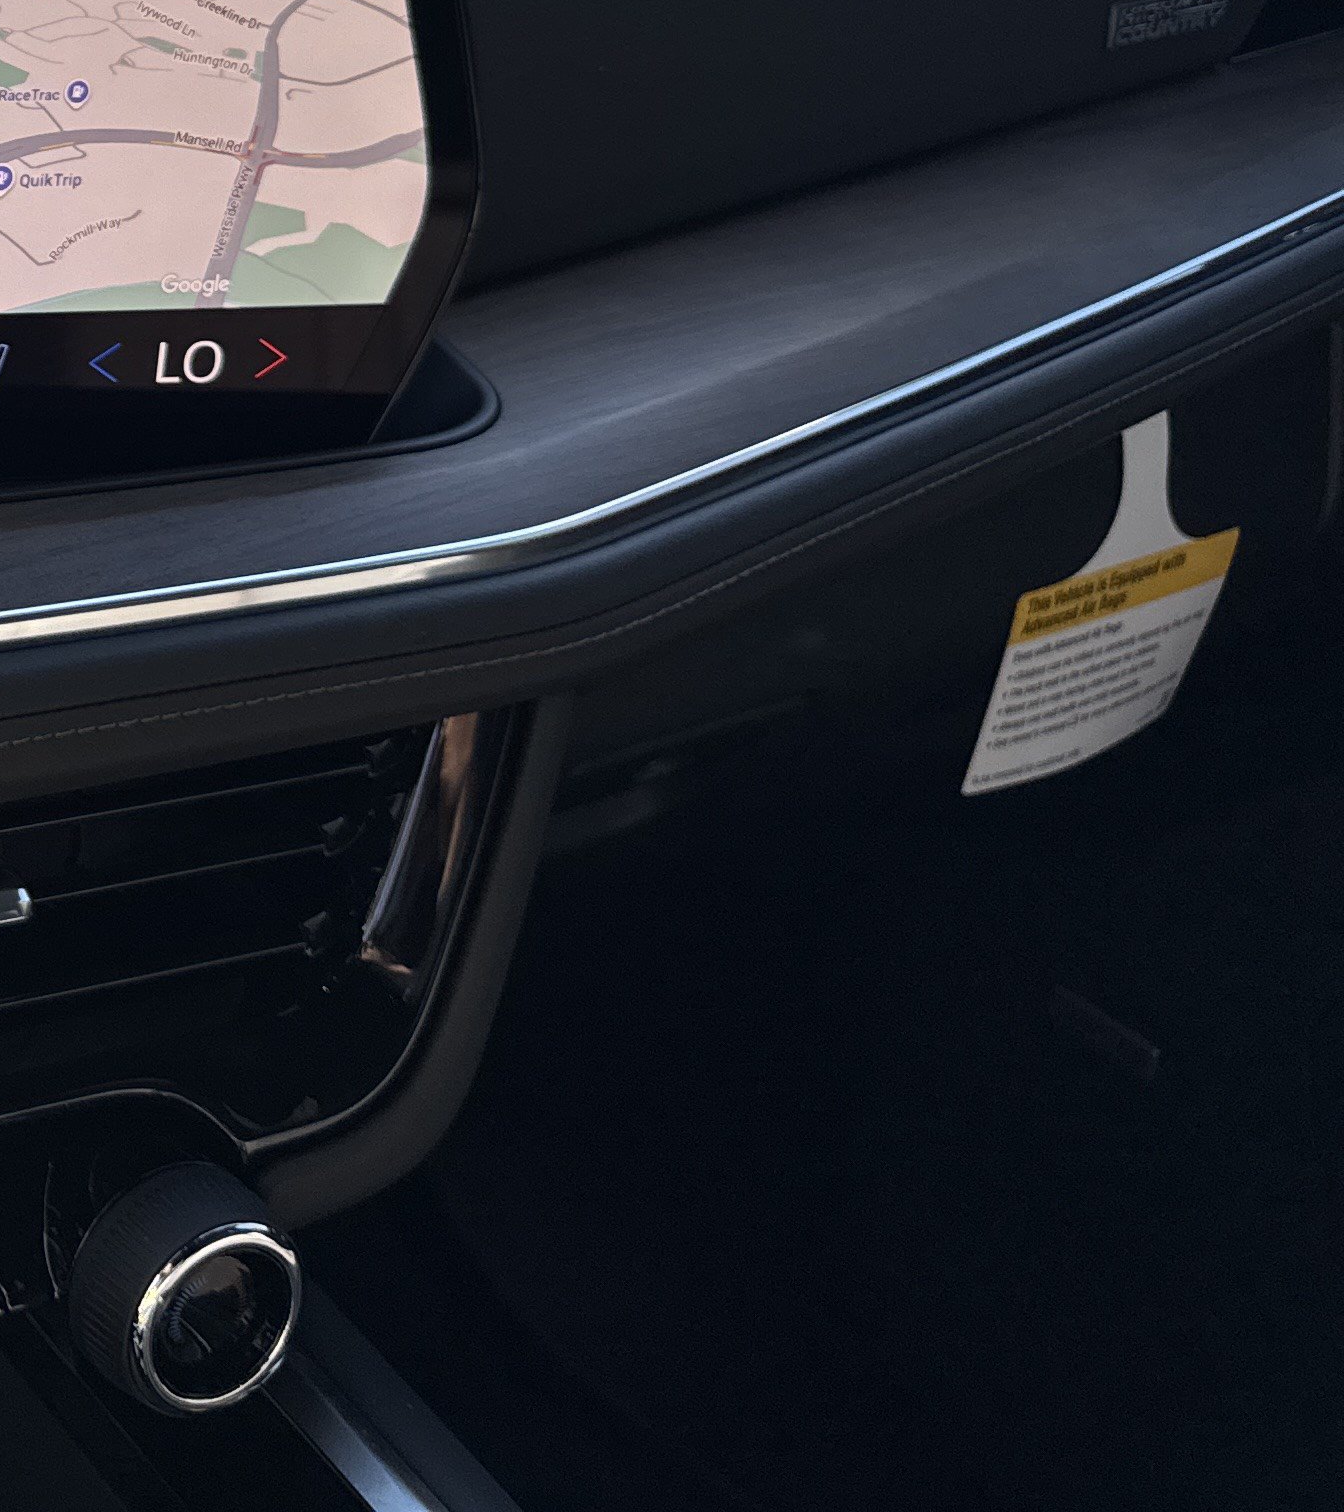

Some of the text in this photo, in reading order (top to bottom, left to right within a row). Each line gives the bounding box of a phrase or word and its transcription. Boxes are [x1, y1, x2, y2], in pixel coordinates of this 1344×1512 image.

[136, 0, 197, 39] Ivywood Ln
[247, 18, 263, 30] Dr
[173, 50, 254, 76] Huntington Dr
[175, 131, 242, 153] Mansell Rd
[212, 165, 253, 258] Westside Pkwy
[49, 217, 122, 261] Rockmill Way
[161, 274, 230, 298] Google
[155, 339, 225, 384] LO
